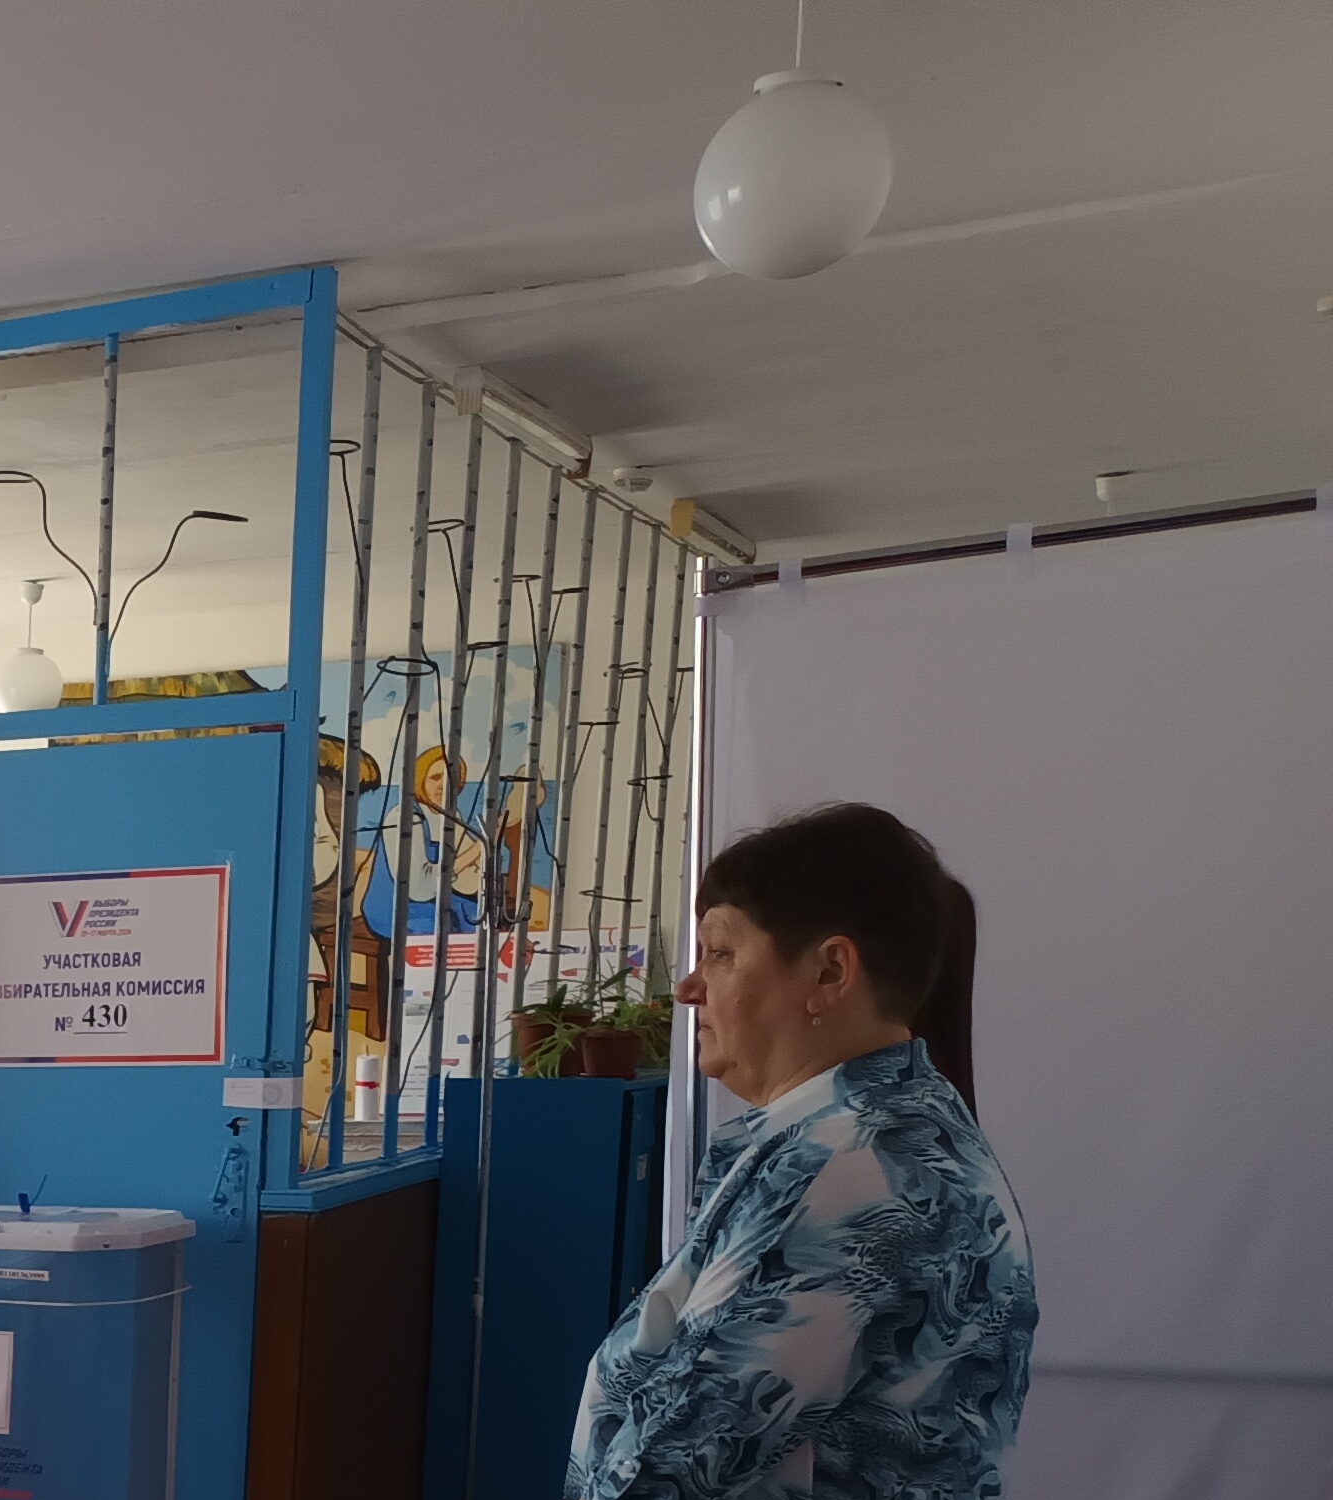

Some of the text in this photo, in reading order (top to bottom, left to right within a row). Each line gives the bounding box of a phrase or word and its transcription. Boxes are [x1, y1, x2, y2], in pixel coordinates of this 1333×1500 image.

[42, 951, 142, 970] УЧАСТКОВАЯ
[116, 978, 205, 997] КОМИССИЯ
[54, 1003, 128, 1032] № 430
